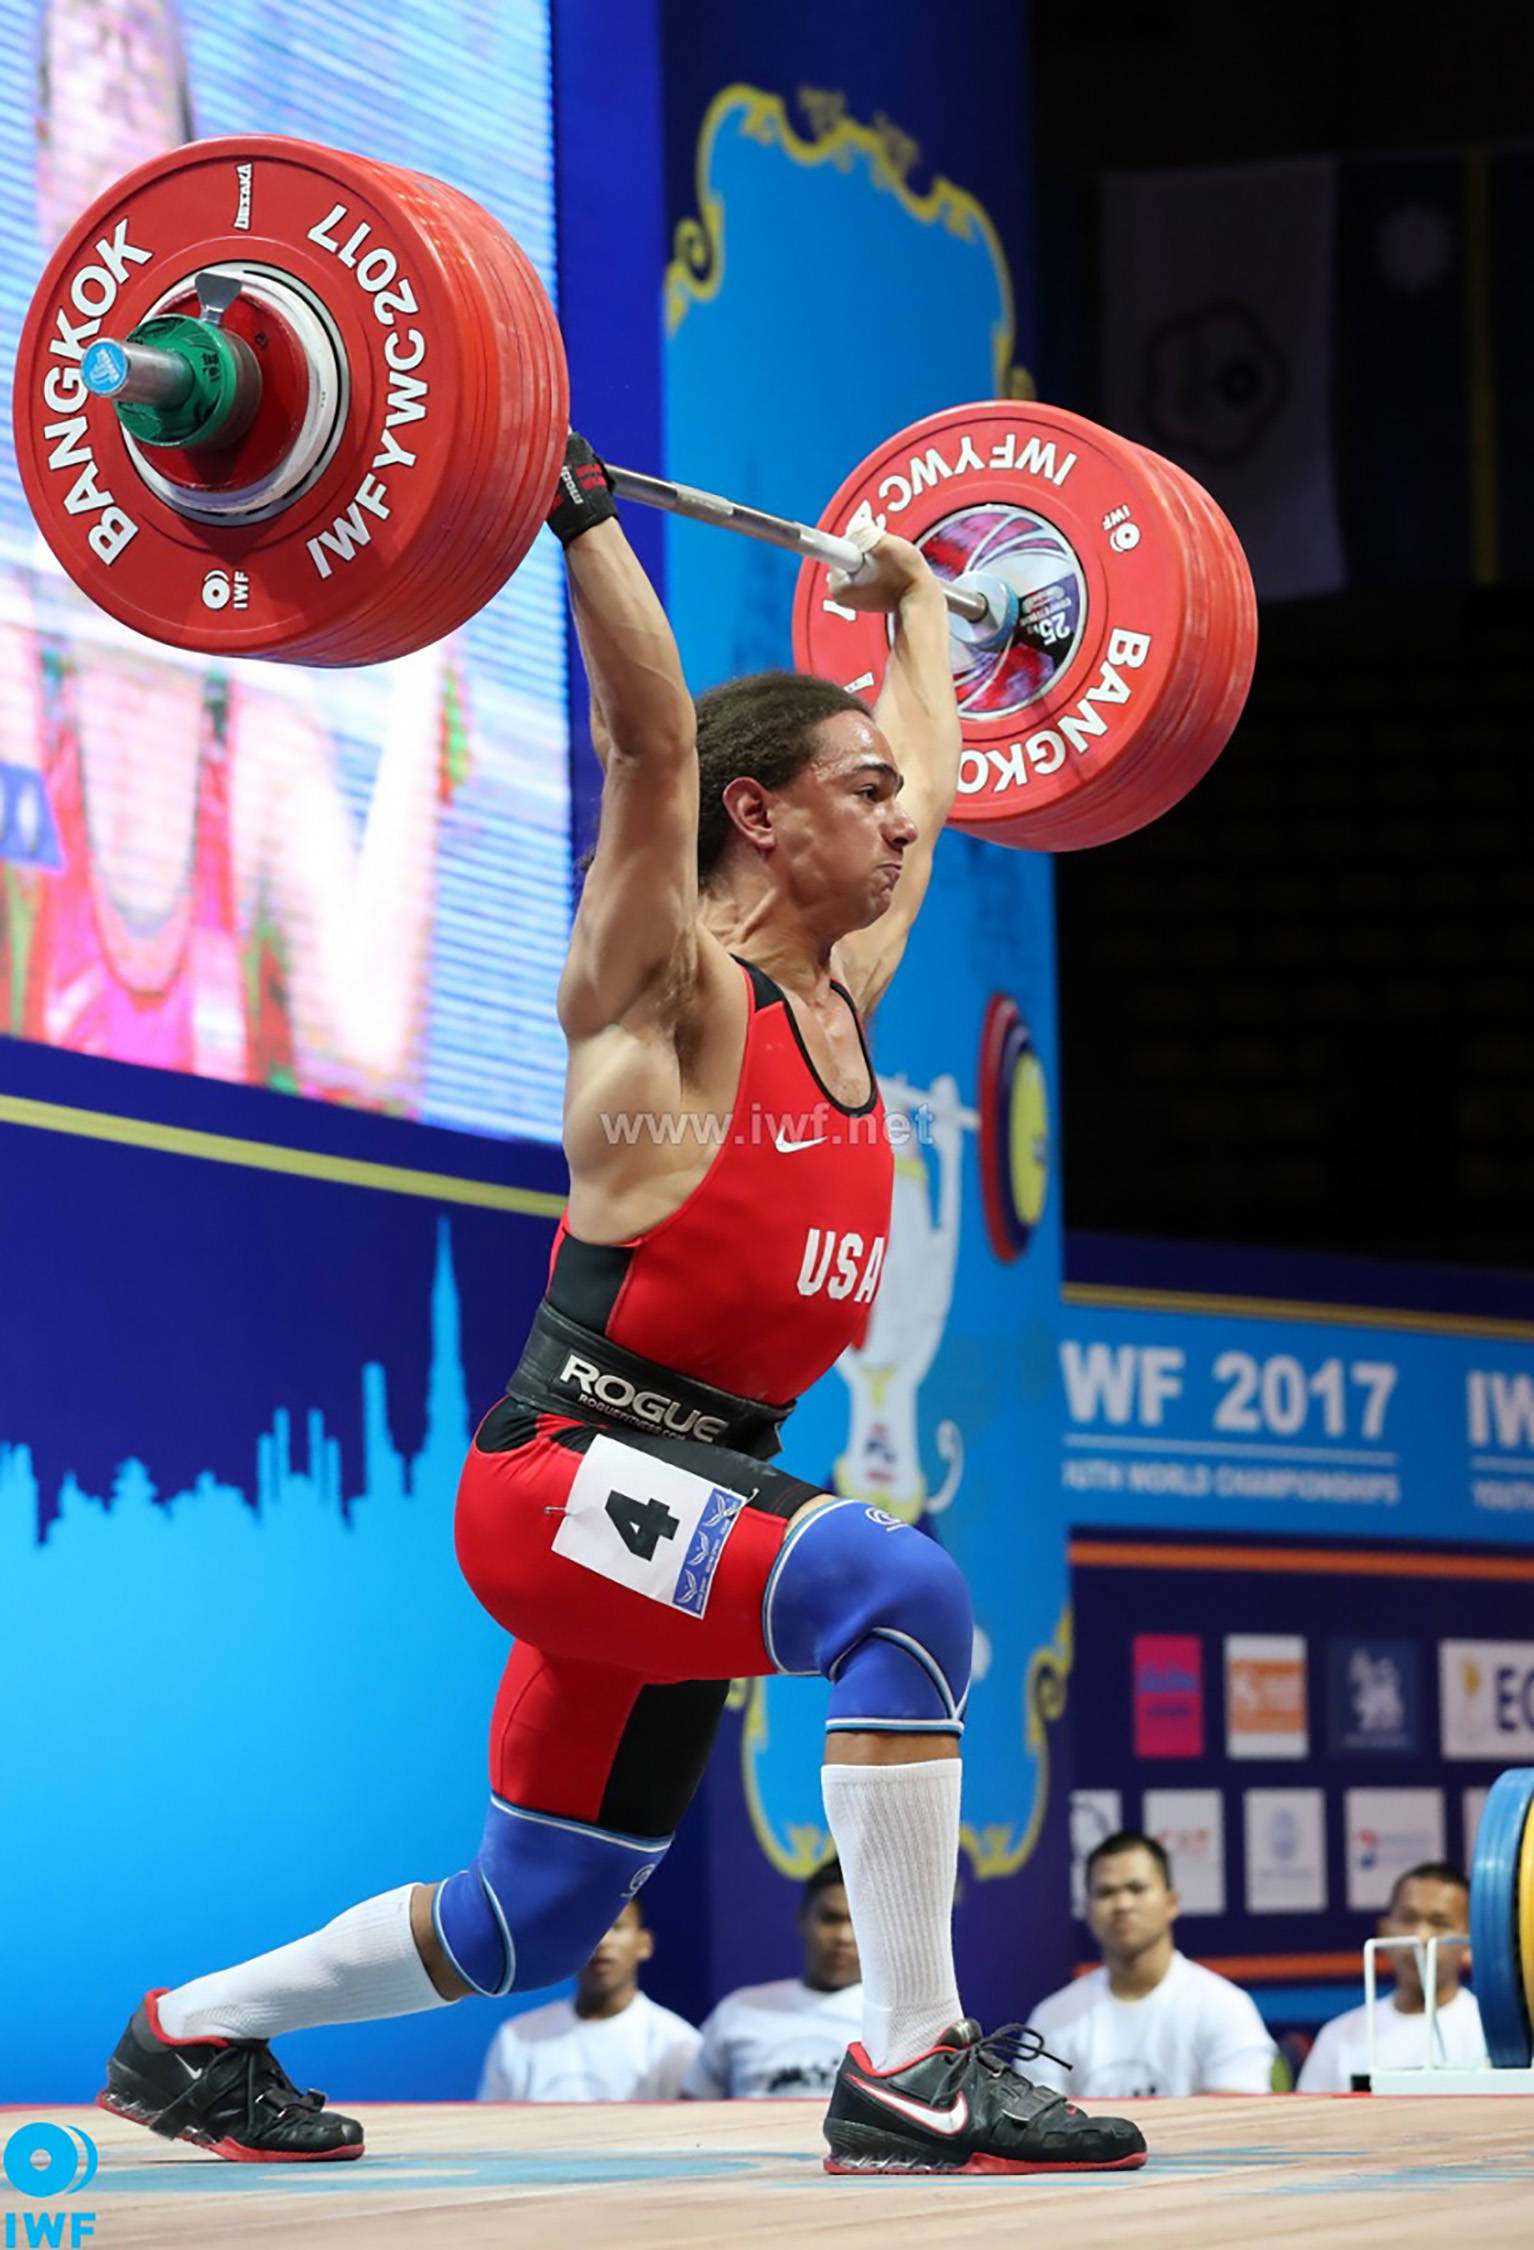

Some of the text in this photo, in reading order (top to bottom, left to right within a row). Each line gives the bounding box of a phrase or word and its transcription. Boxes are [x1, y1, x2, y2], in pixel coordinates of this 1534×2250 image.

[43, 218, 154, 566] BANGKOK
[305, 204, 429, 580] IWFYWC2017
[1102, 504, 1130, 530] IWF
[233, 570, 248, 608] IWF
[956, 628, 1152, 795] BANGKO
[797, 1227, 885, 1303] USA
[560, 1354, 729, 1443] ROGUE
[1060, 1340, 1398, 1440] WF 2017
[1467, 1370, 1534, 1450] IW
[604, 1489, 680, 1562] 4
